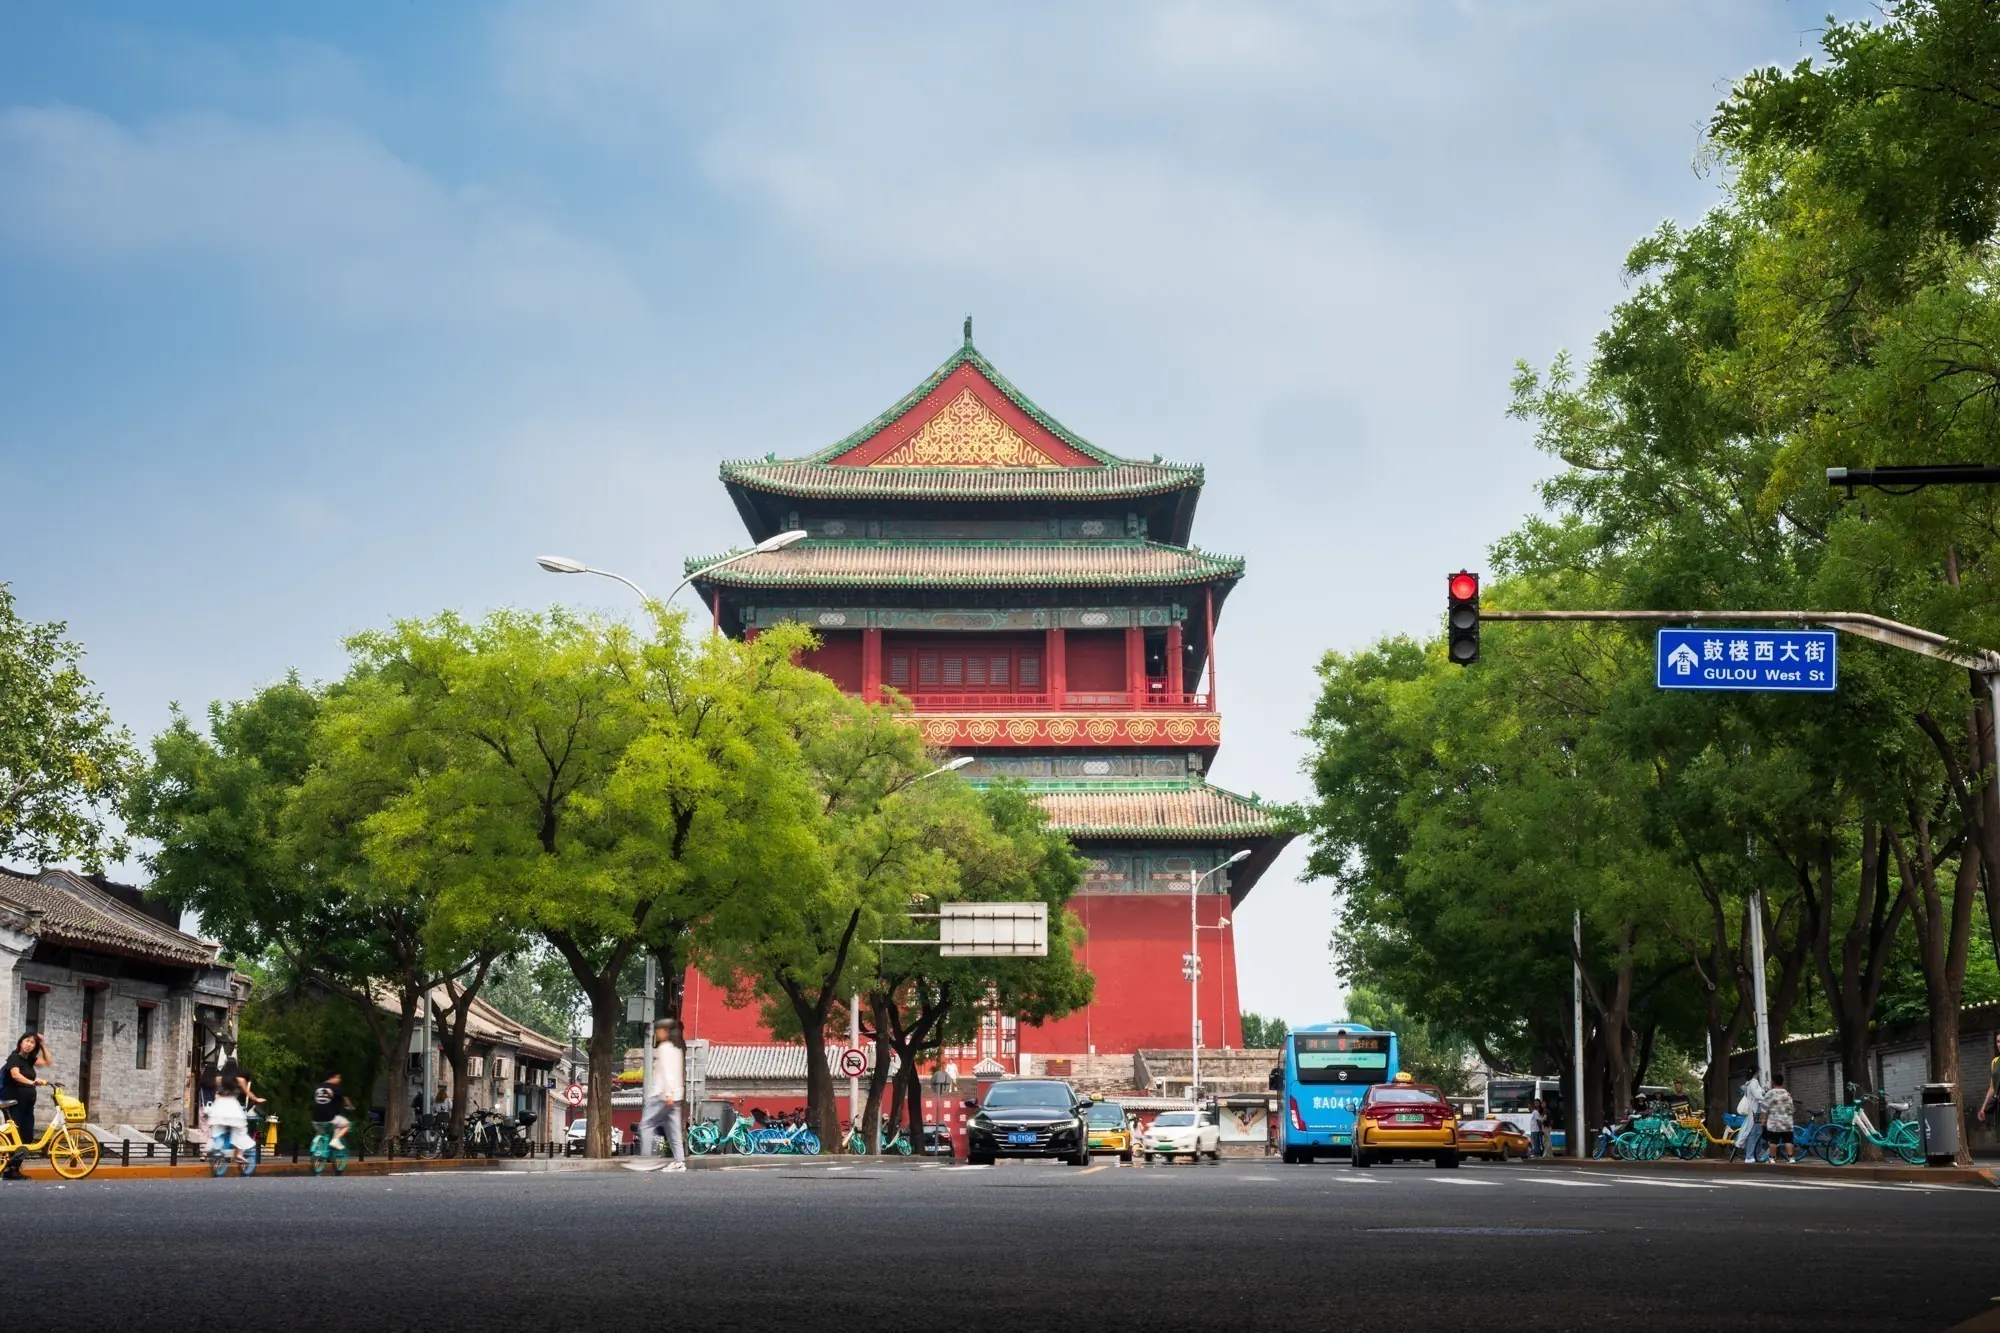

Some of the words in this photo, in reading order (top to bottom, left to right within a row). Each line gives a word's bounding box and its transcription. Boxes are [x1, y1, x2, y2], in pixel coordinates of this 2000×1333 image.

[1703, 638, 1825, 663] 鼓楼西大街
[1677, 651, 1690, 663] 东
[1680, 664, 1688, 673] E
[1704, 668, 1757, 681] GULOU
[1765, 669, 1801, 681] West
[1809, 669, 1825, 681] St
